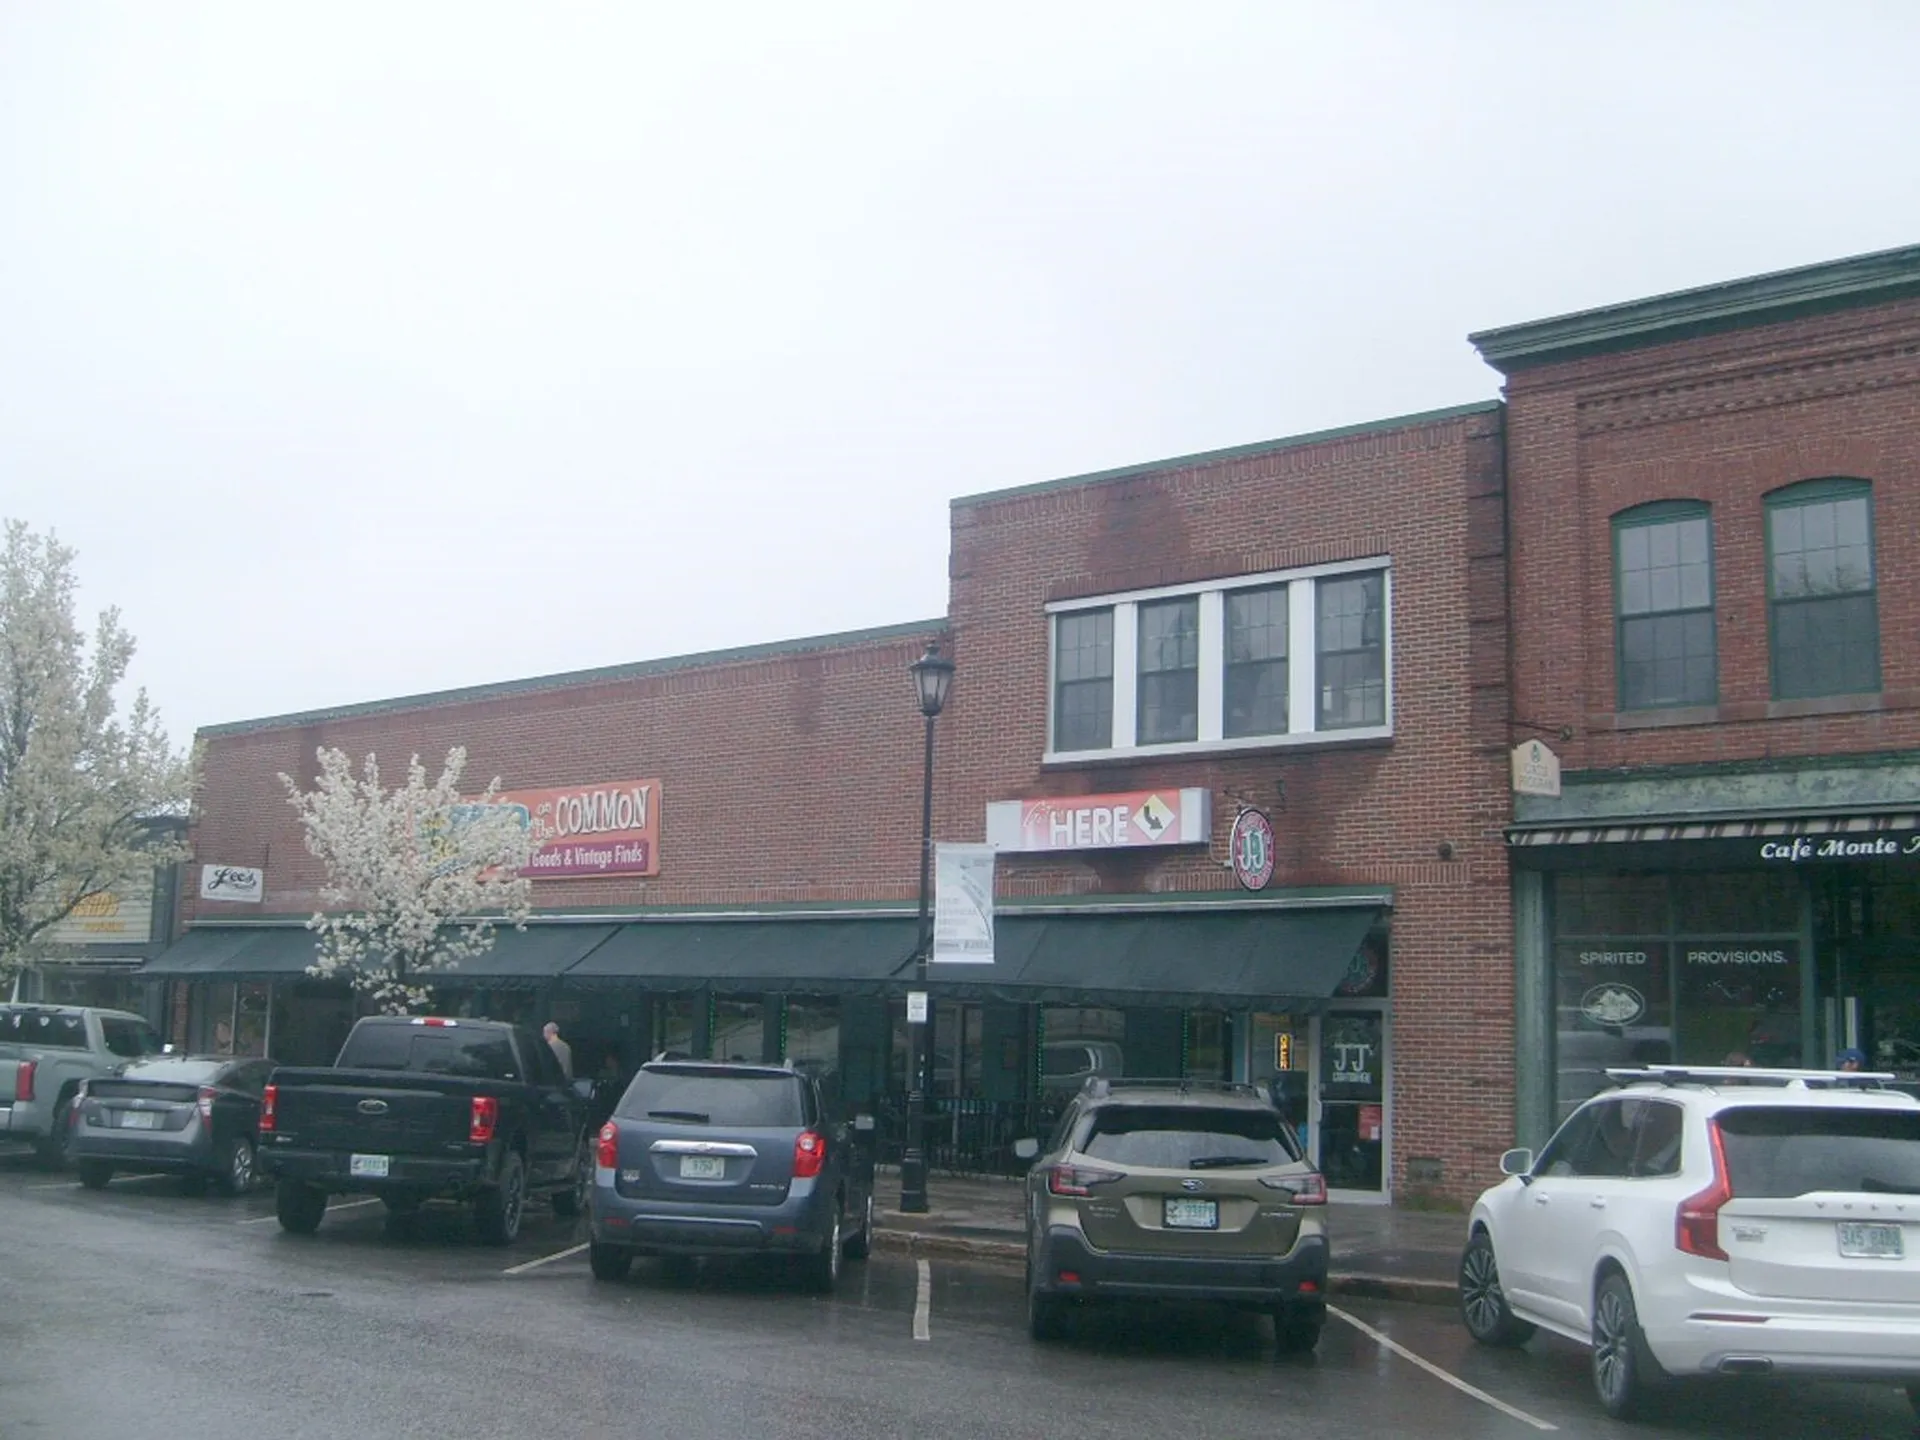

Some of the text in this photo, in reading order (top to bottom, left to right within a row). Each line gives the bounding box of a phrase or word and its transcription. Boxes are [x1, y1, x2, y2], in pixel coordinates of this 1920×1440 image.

[556, 785, 651, 837] COMMON
[1051, 806, 1129, 847] HERE
[564, 849, 573, 865] &
[575, 847, 612, 869] Vintage
[615, 842, 643, 864] Finds
[1760, 838, 1812, 861] Café
[1817, 838, 1897, 856] Monte
[1580, 951, 1788, 965] SPIRITED PROVISIONS.
